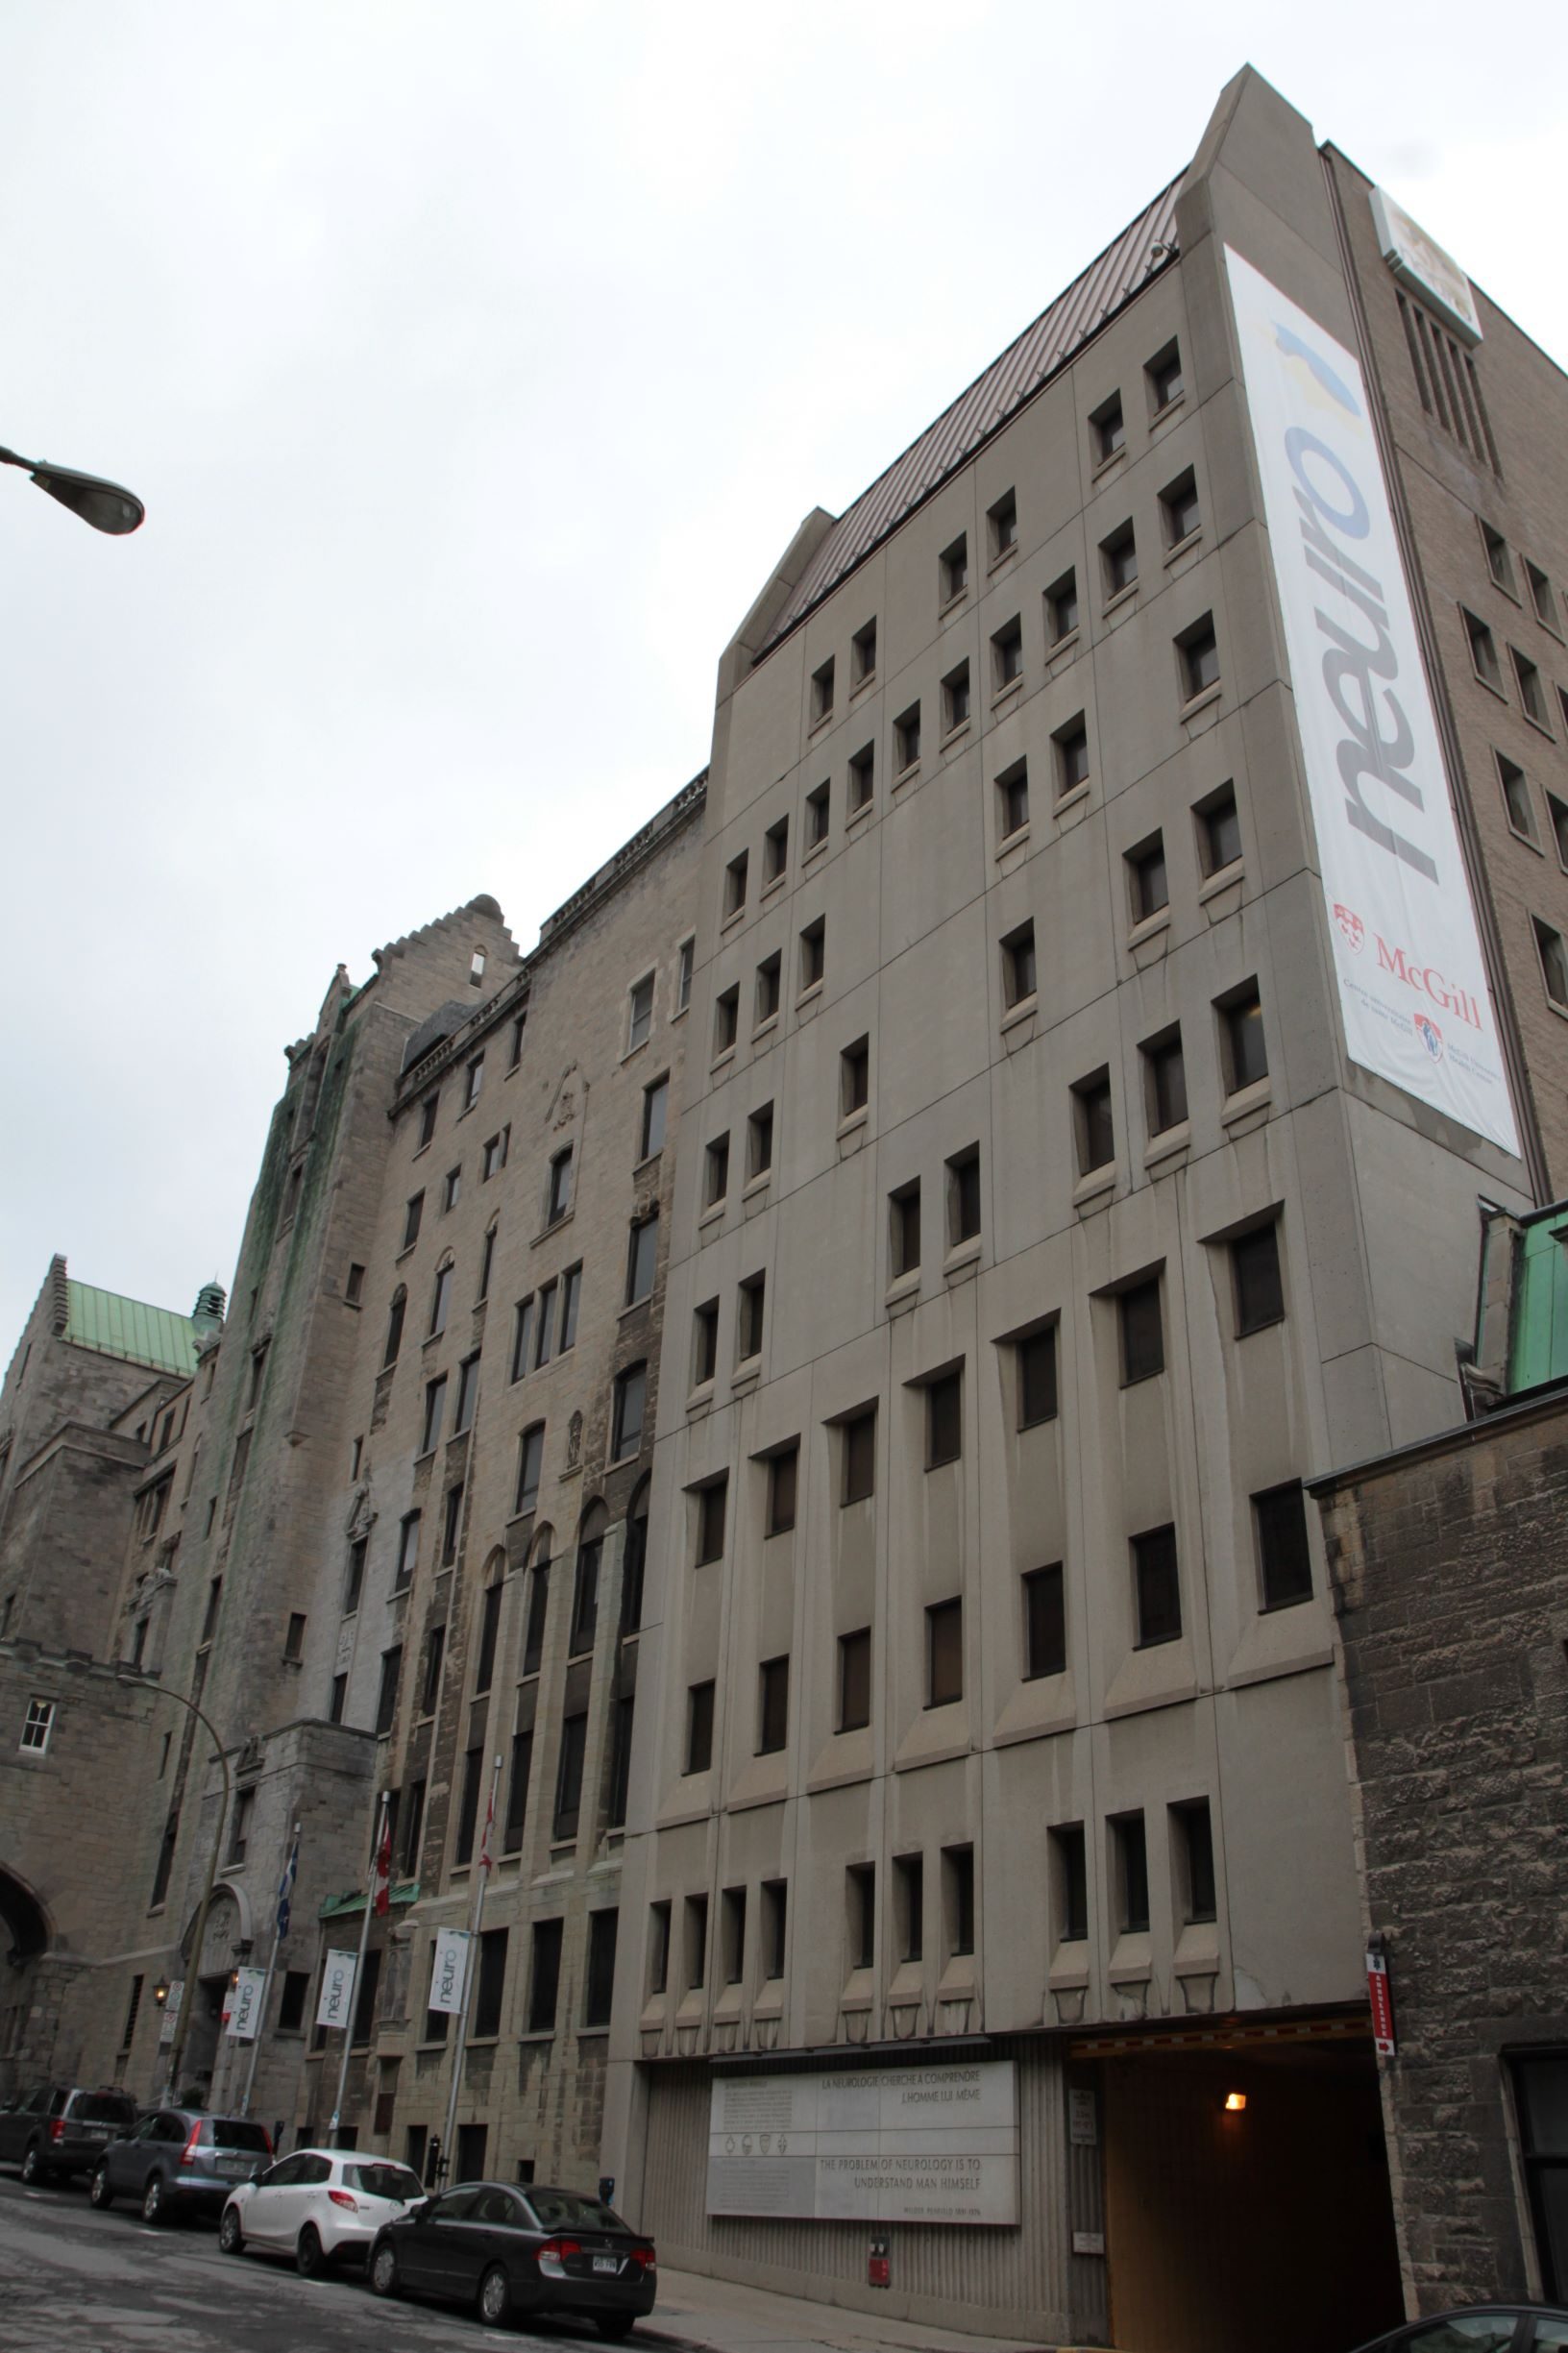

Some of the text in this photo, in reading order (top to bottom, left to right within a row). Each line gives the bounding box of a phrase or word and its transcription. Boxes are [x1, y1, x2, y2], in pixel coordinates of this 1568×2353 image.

[1285, 427, 1439, 885] neuro
[1372, 932, 1483, 1031] McGill
[327, 1969, 344, 2020] neuro
[440, 1949, 457, 2003] neuro
[235, 1984, 254, 2030] neuro
[821, 2078, 831, 2090] LA
[832, 2075, 879, 2089] NEUROLOGIE
[881, 2073, 917, 2087] CHERCHE
[924, 2070, 981, 2084] COMPRENDRE
[821, 2159, 981, 2170] THE PROBLEM OF NEUROLOGY IS TO
[854, 2177, 981, 2190] UNDERSTAND MAN HIMSELF
